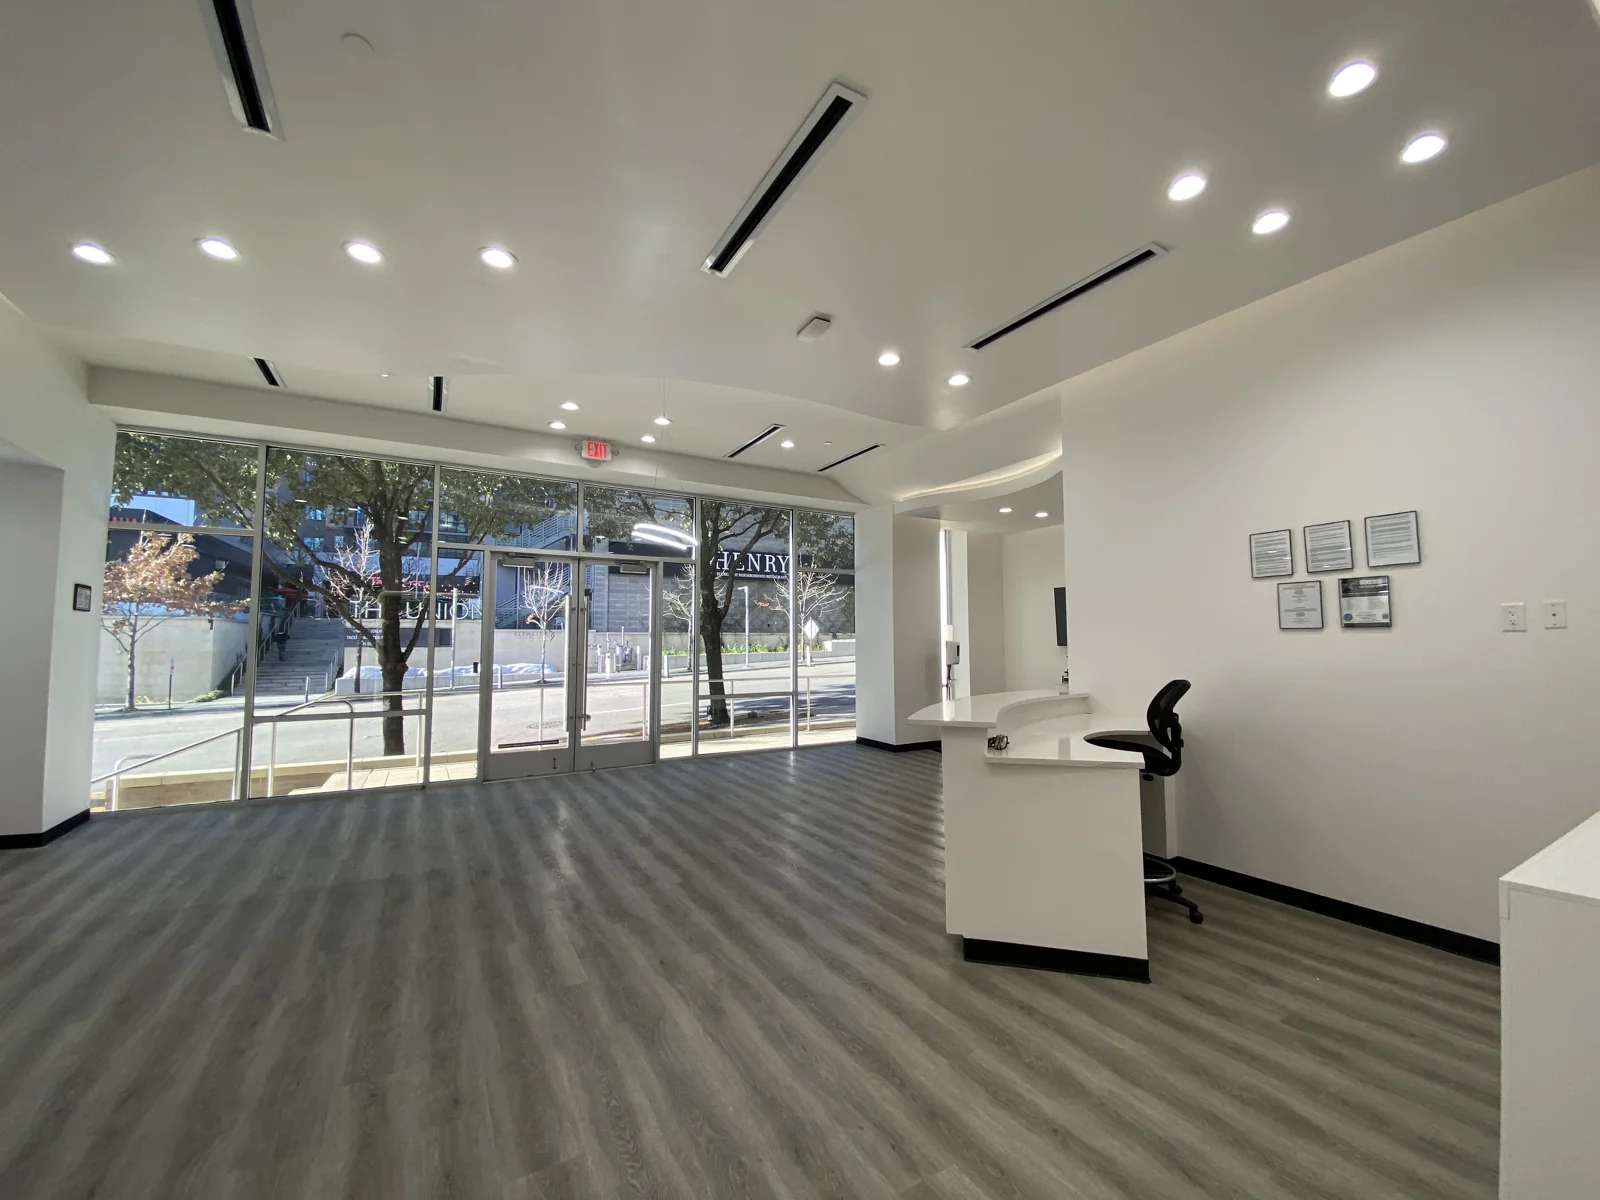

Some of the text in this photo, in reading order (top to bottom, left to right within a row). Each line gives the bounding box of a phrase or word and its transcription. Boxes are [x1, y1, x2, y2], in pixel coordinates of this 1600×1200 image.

[587, 441, 608, 459] EXIT
[716, 551, 790, 573] HENRY
[350, 600, 382, 619] TH
